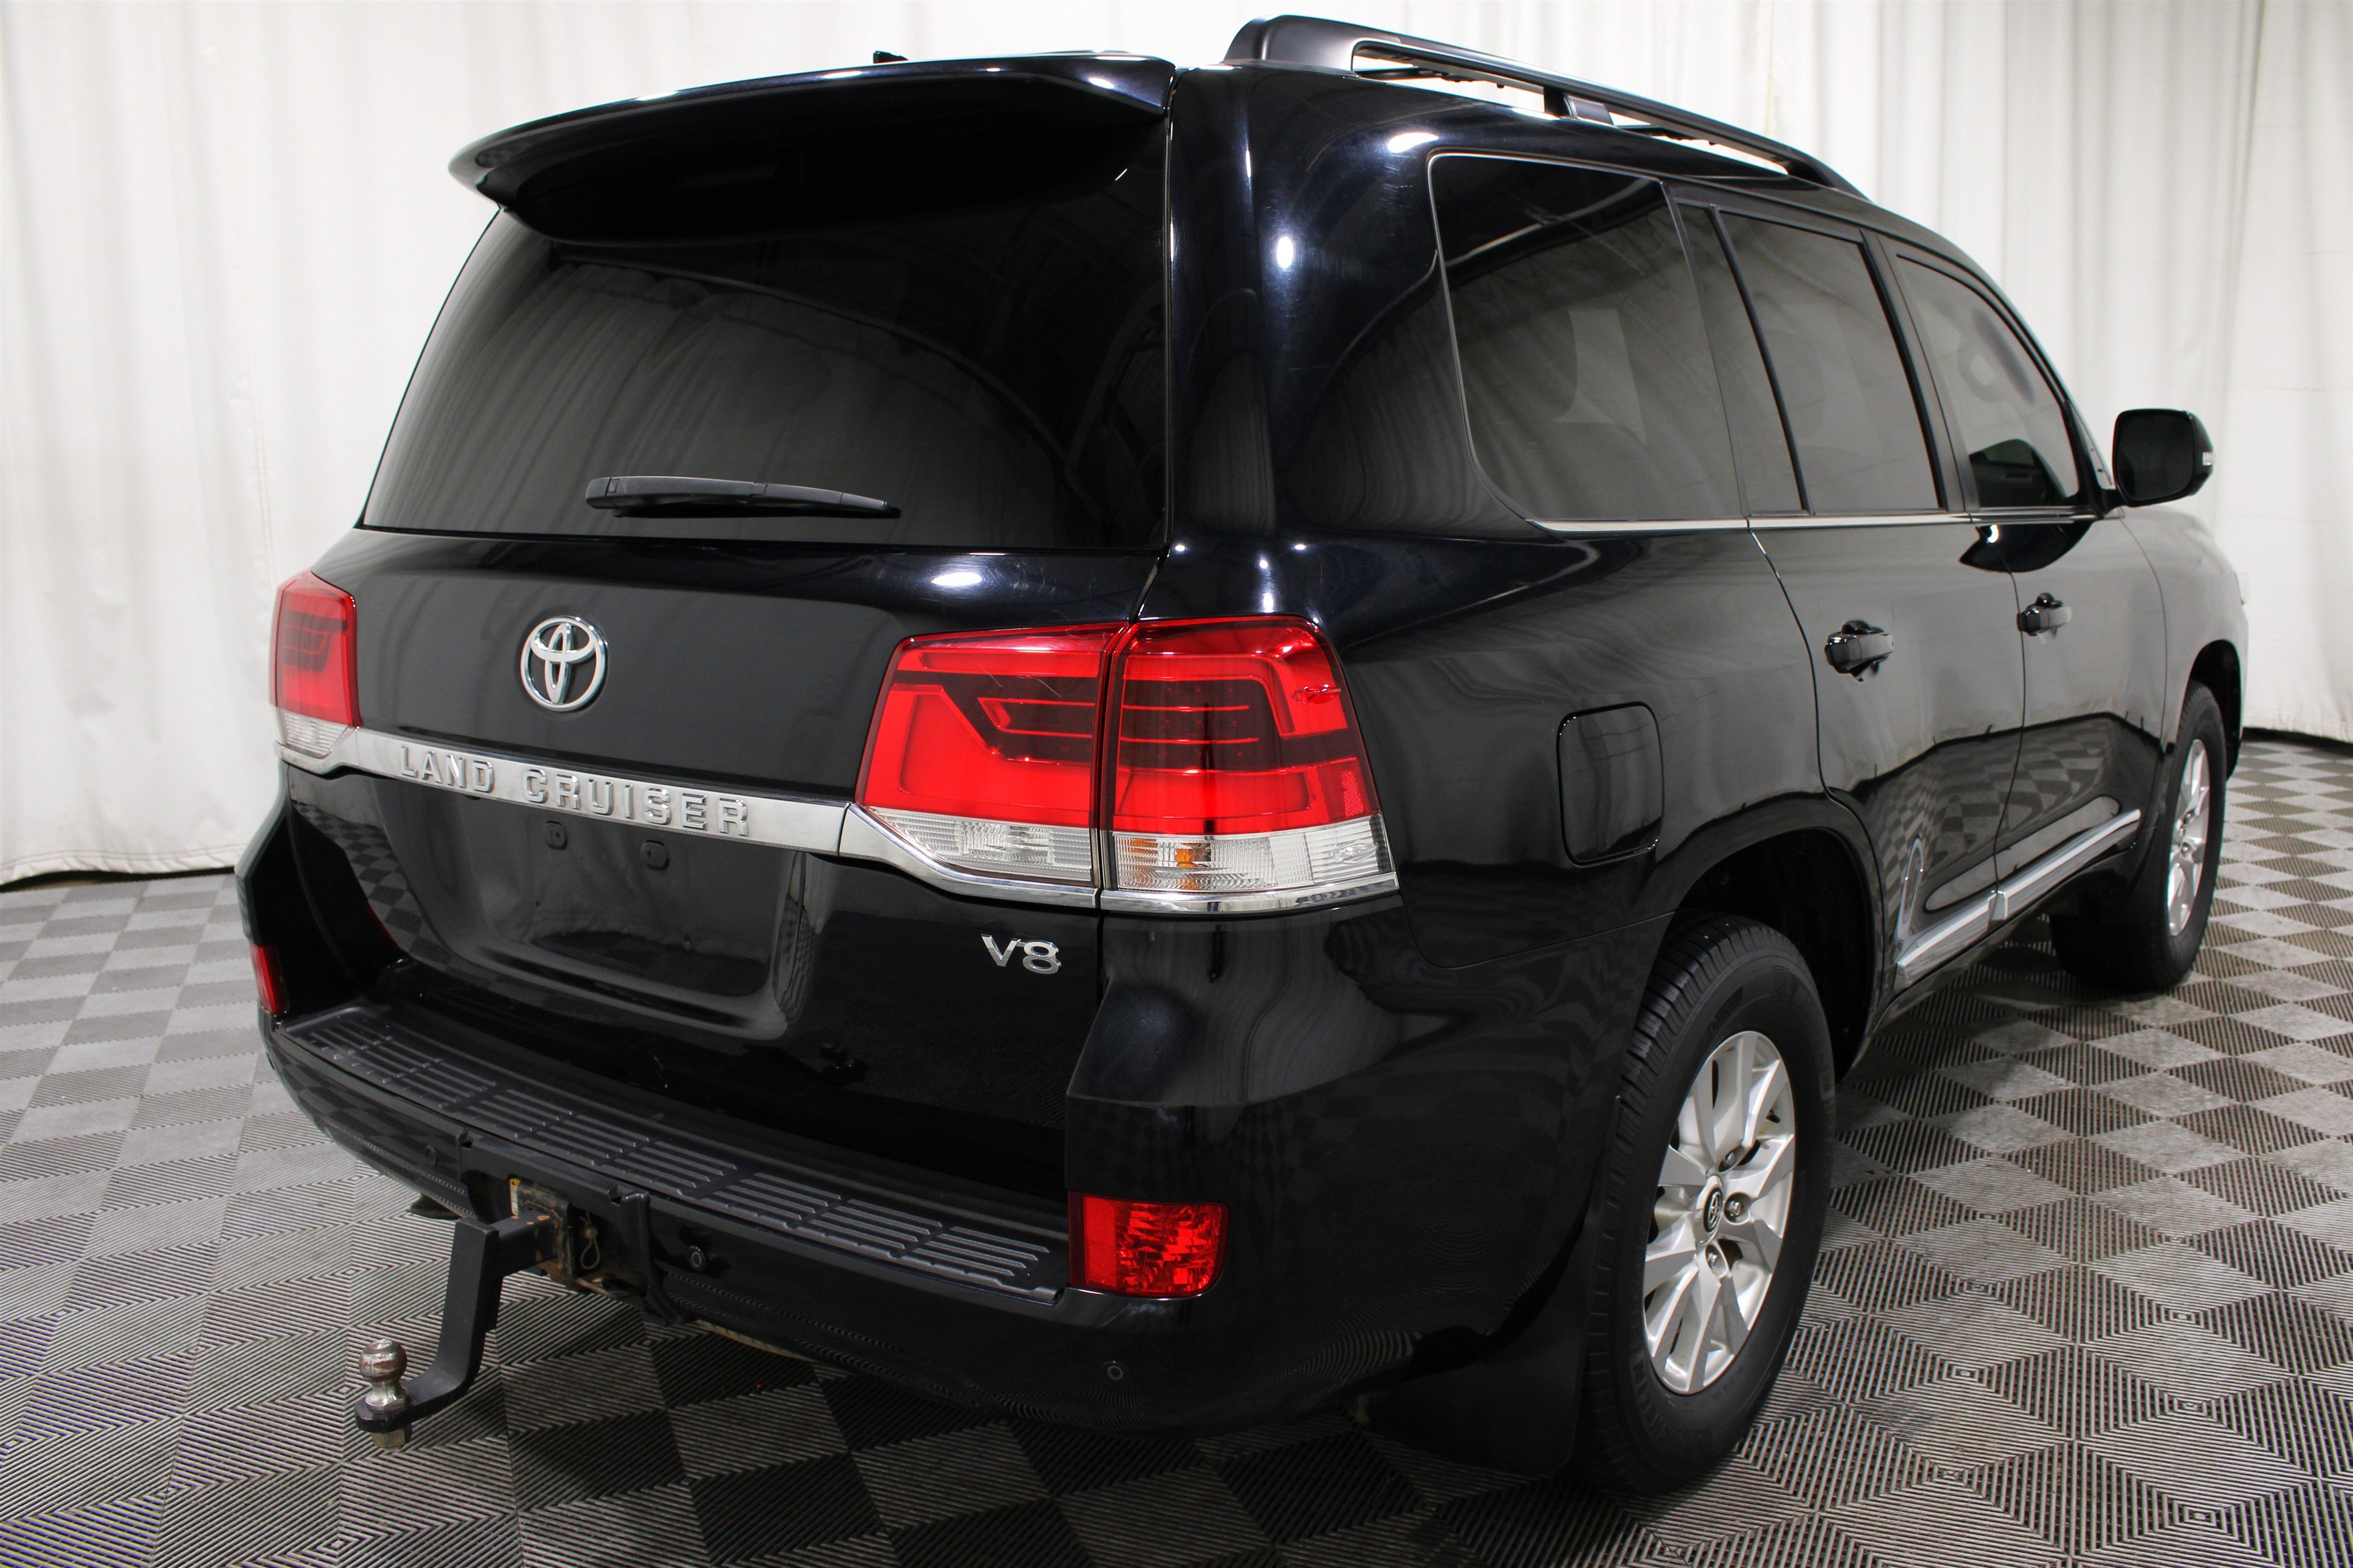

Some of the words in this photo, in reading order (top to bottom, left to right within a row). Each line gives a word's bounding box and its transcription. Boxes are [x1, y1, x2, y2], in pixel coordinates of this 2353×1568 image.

[400, 745, 495, 794] LAND
[523, 768, 749, 837] CRUISER
[981, 934, 1062, 974] V8
